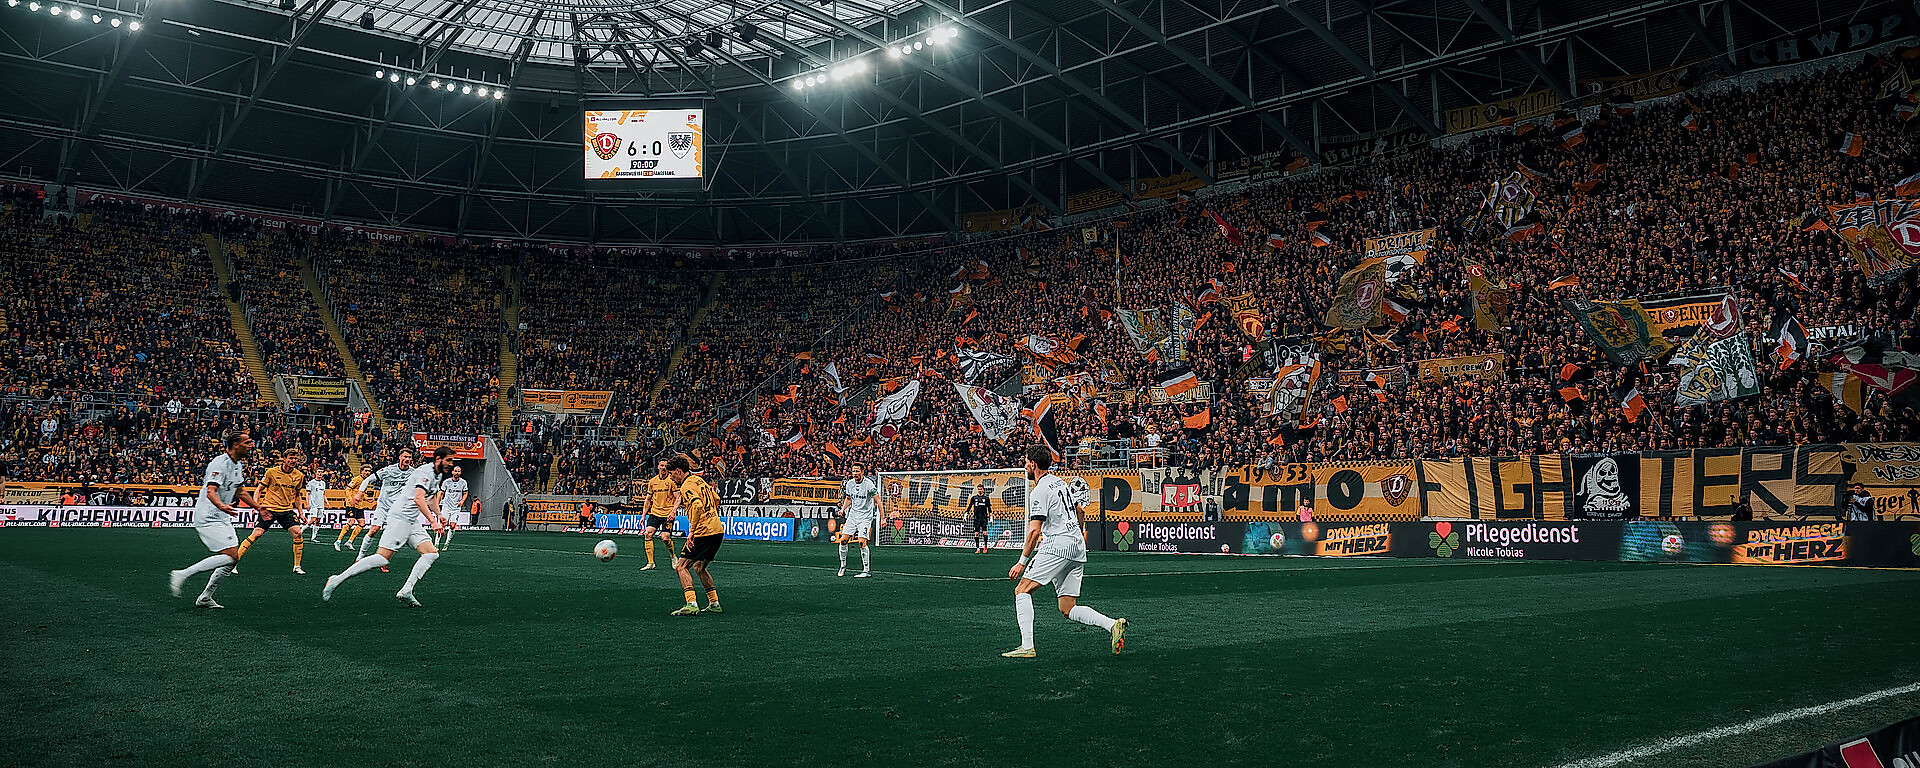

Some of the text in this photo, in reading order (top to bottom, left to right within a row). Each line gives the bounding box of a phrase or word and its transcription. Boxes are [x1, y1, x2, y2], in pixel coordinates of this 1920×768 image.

[1287, 465, 1307, 480] 53
[1138, 523, 1215, 542] Pflegedienst
[1327, 523, 1388, 538] DYNAMISCH
[1466, 523, 1579, 546] Pflegedienst
[1748, 522, 1844, 541] DYNAMISCH
[1138, 542, 1178, 551] Nicole Tobias
[1325, 536, 1387, 554] MIT HERZ
[1467, 547, 1524, 557] Nicole Tobias
[1746, 540, 1842, 561] MIT HERZ
